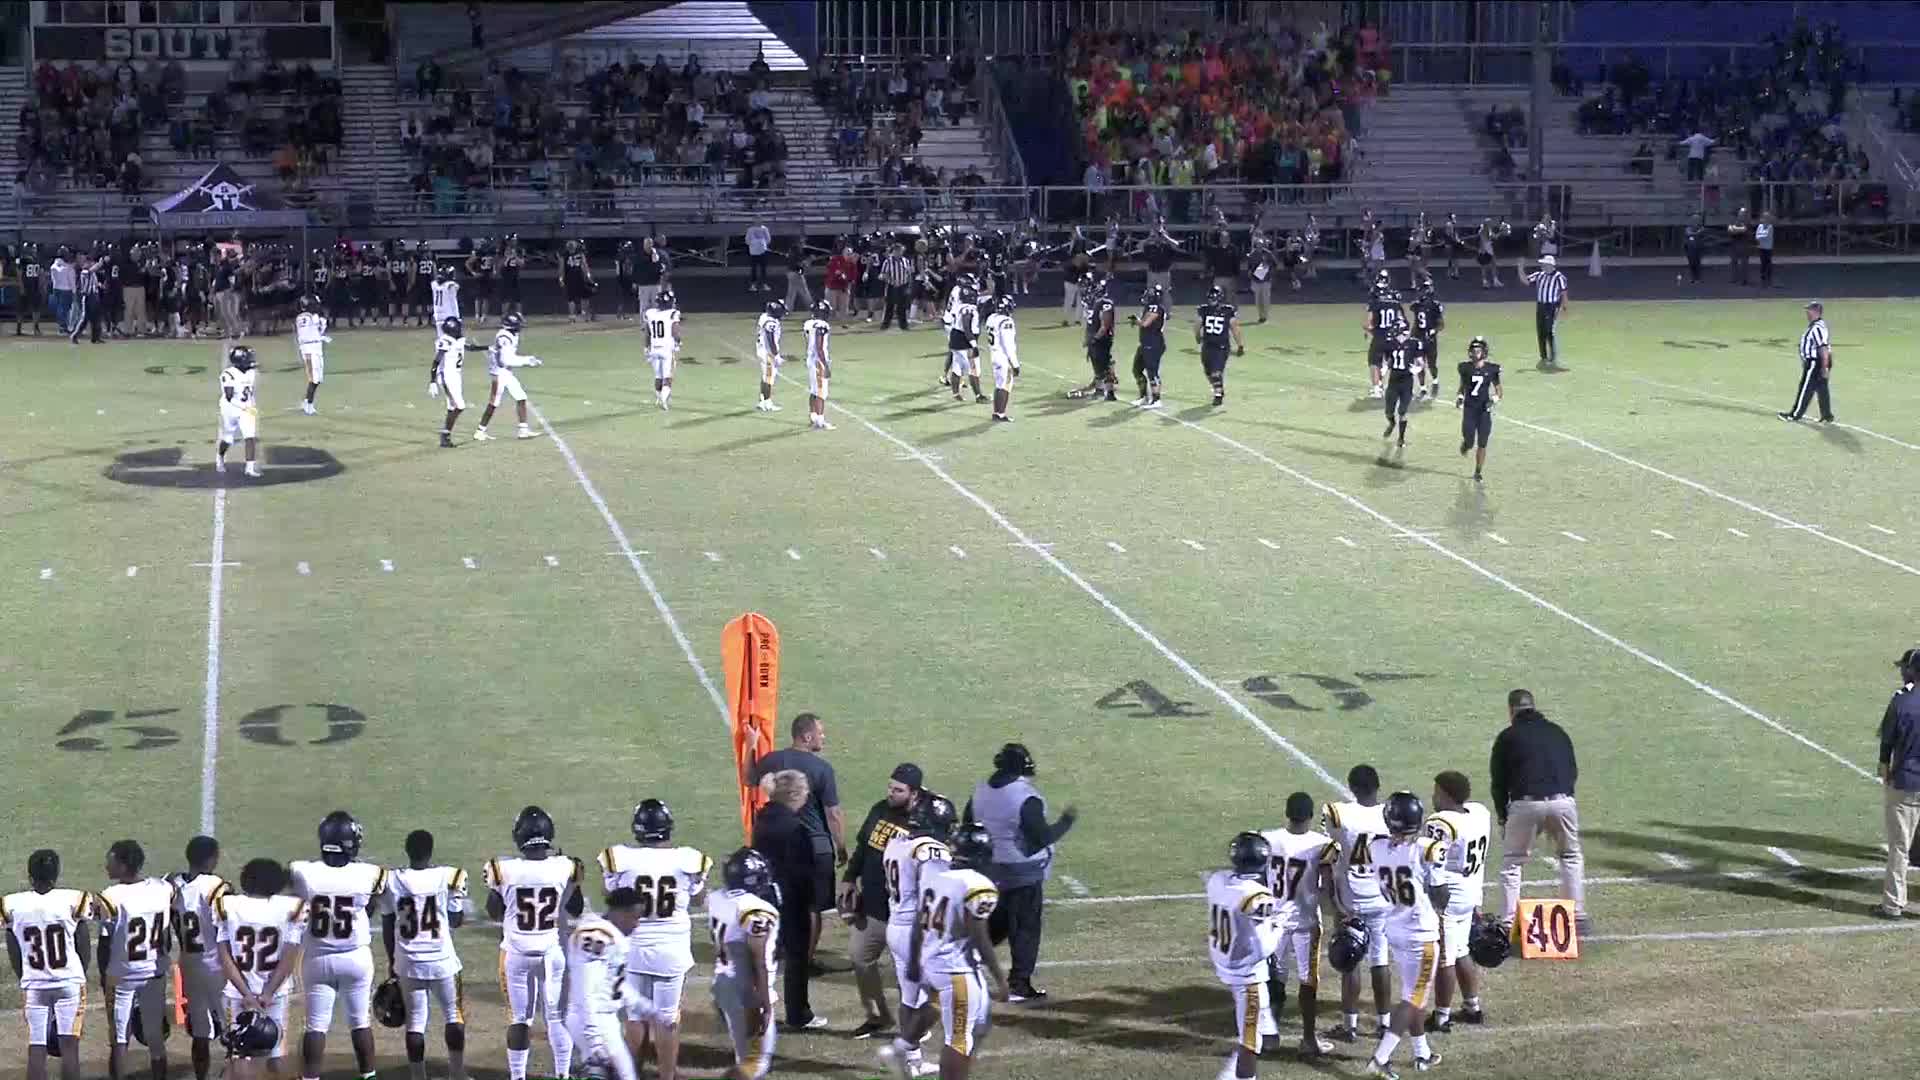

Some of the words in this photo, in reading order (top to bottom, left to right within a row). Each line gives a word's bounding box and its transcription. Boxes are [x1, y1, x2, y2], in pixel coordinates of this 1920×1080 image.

[105, 28, 268, 59] SOUTH
[26, 263, 40, 278] 80
[650, 320, 665, 339] 10
[1204, 315, 1225, 335] 55
[1392, 350, 1405, 370] 11
[1470, 375, 1484, 397] 7
[55, 703, 368, 751] 50
[1271, 855, 1307, 900] 37
[1379, 865, 1415, 907] 36
[311, 894, 354, 939] 65
[397, 895, 441, 940] 34
[515, 886, 558, 932] 52
[1526, 903, 1571, 953] 40
[23, 922, 68, 970] 30
[127, 912, 166, 962] 24
[235, 925, 280, 972] 32
